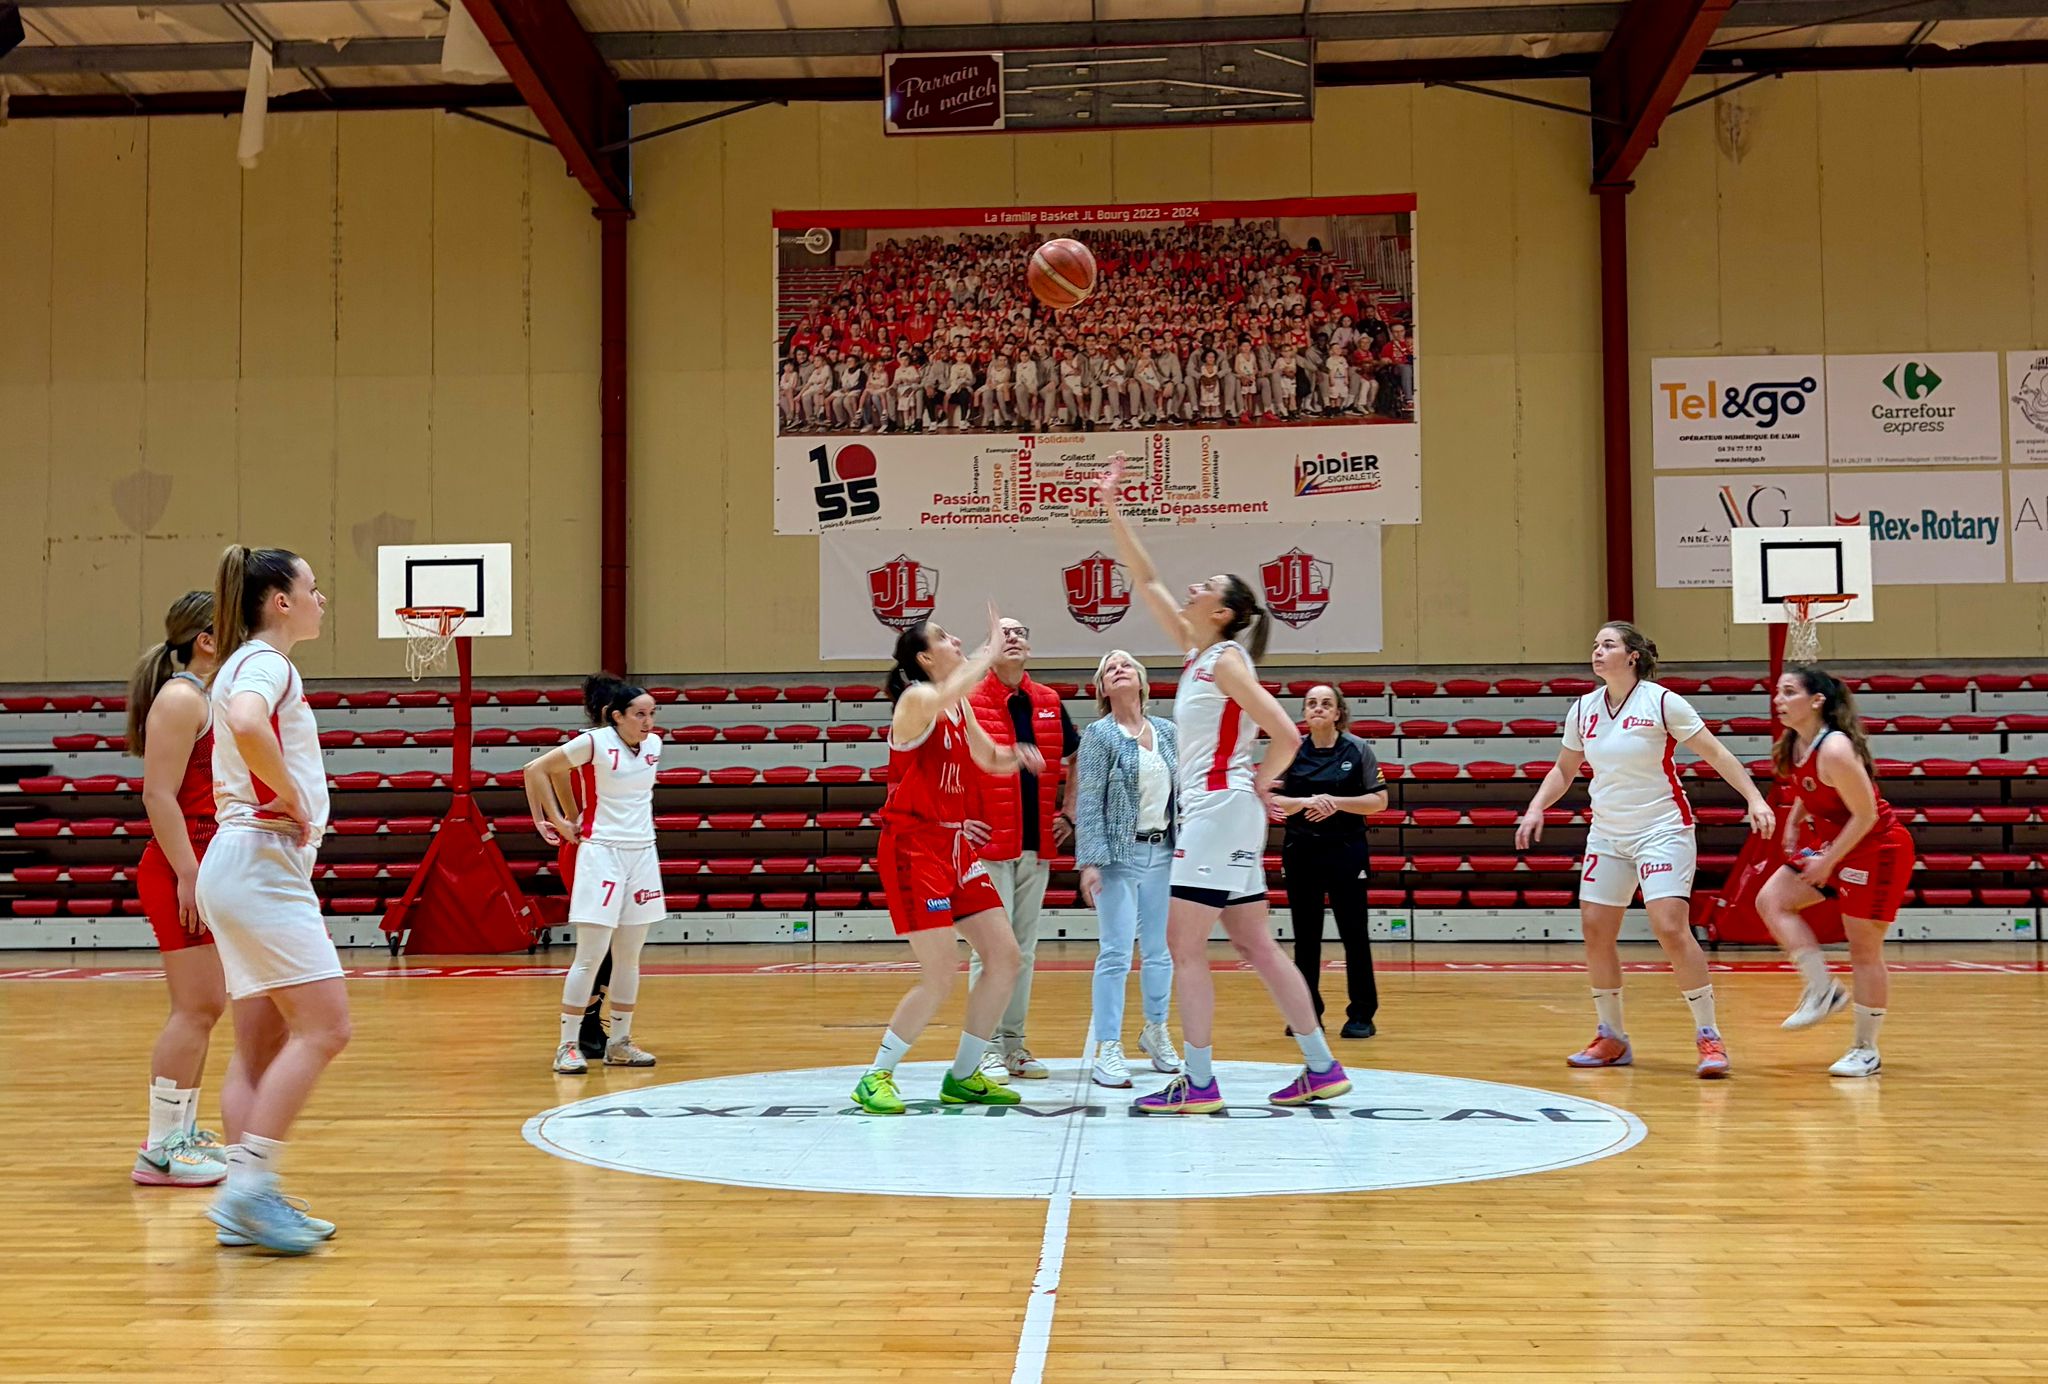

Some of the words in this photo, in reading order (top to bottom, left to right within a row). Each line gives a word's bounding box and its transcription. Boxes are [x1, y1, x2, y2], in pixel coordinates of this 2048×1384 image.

[896, 66, 979, 98] Parrain
[907, 100, 930, 120] du
[940, 77, 997, 111] match
[985, 213, 997, 222] La
[1000, 211, 1037, 222] famille
[1041, 211, 1079, 221] Basket
[1083, 211, 1095, 220] JL
[1097, 209, 1130, 221] Bourg
[1133, 209, 1160, 219] 2023
[1172, 207, 1200, 218] 2024
[1660, 377, 1817, 428] Tel&go
[1871, 403, 1955, 419] Carrefour
[1680, 432, 1723, 441] OPÉRATEUR
[1725, 431, 1768, 440] NUMÉRIQUE
[1769, 432, 1780, 440] DE
[1883, 420, 1945, 436] express
[1038, 434, 1085, 444] Solidarité
[1060, 453, 1096, 462] Collectif
[1018, 435, 1037, 515] Famille
[1151, 432, 1163, 504] Tolérance
[1201, 435, 1211, 499] Convivialité
[992, 462, 1003, 512] Partage
[1166, 490, 1200, 501] Travail
[933, 492, 989, 505] Passion
[1160, 499, 1268, 517] Dépassement
[921, 511, 1019, 524] Performance
[608, 748, 619, 771] 7
[602, 880, 616, 907] 7
